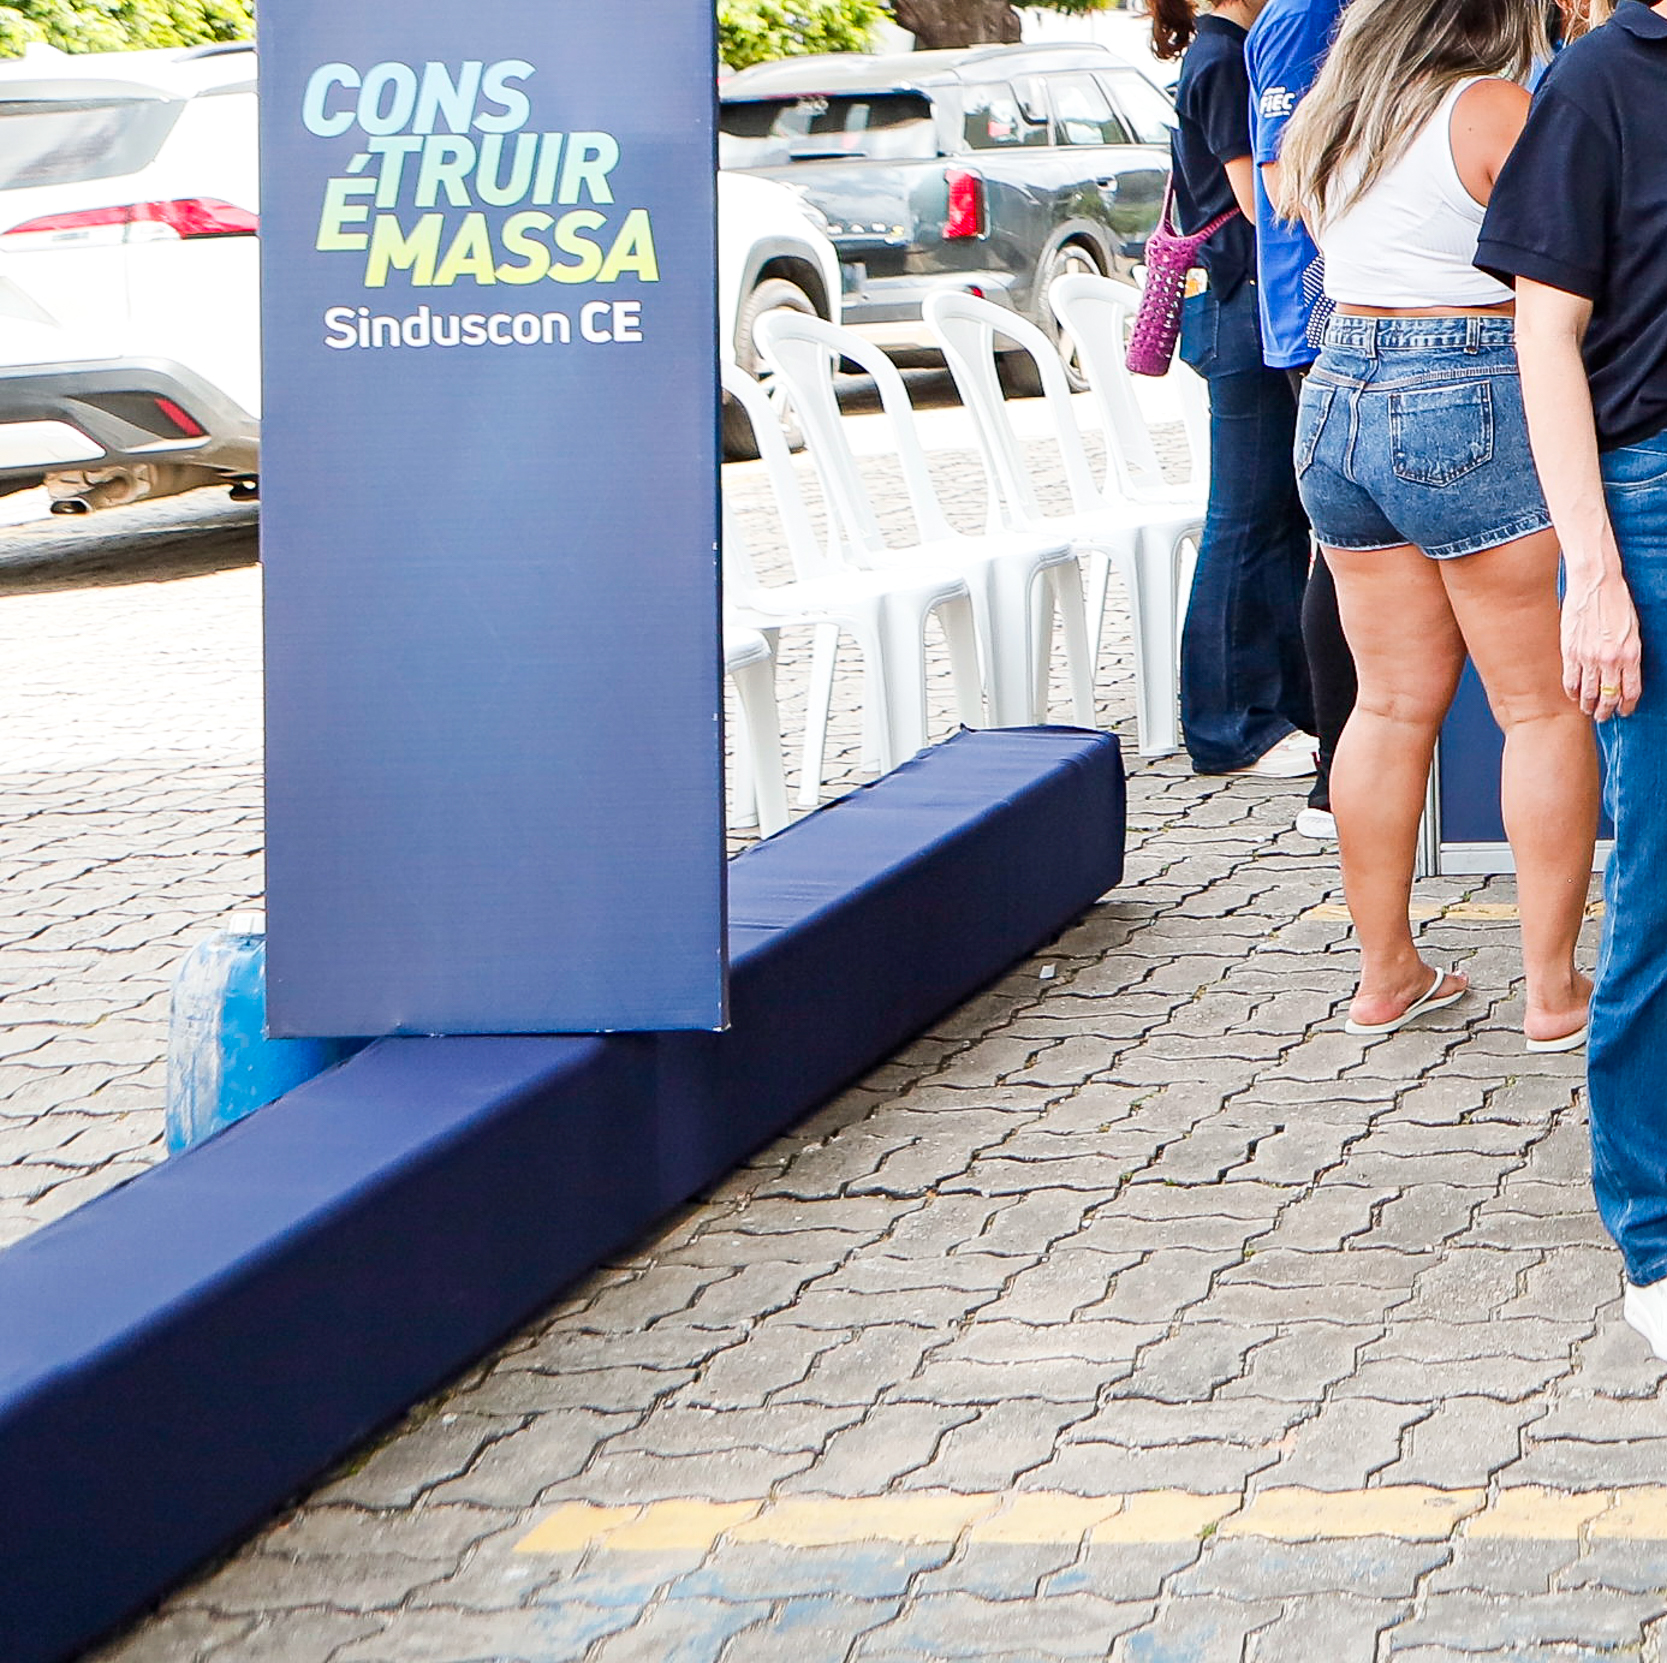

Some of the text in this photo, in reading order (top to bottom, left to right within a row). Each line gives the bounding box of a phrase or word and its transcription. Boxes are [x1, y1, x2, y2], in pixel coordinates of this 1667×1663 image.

[301, 58, 537, 138] CONS
[367, 131, 620, 209] TRUIR
[315, 153, 661, 288] É MASSA
[324, 300, 644, 350] Sinduscon CE
